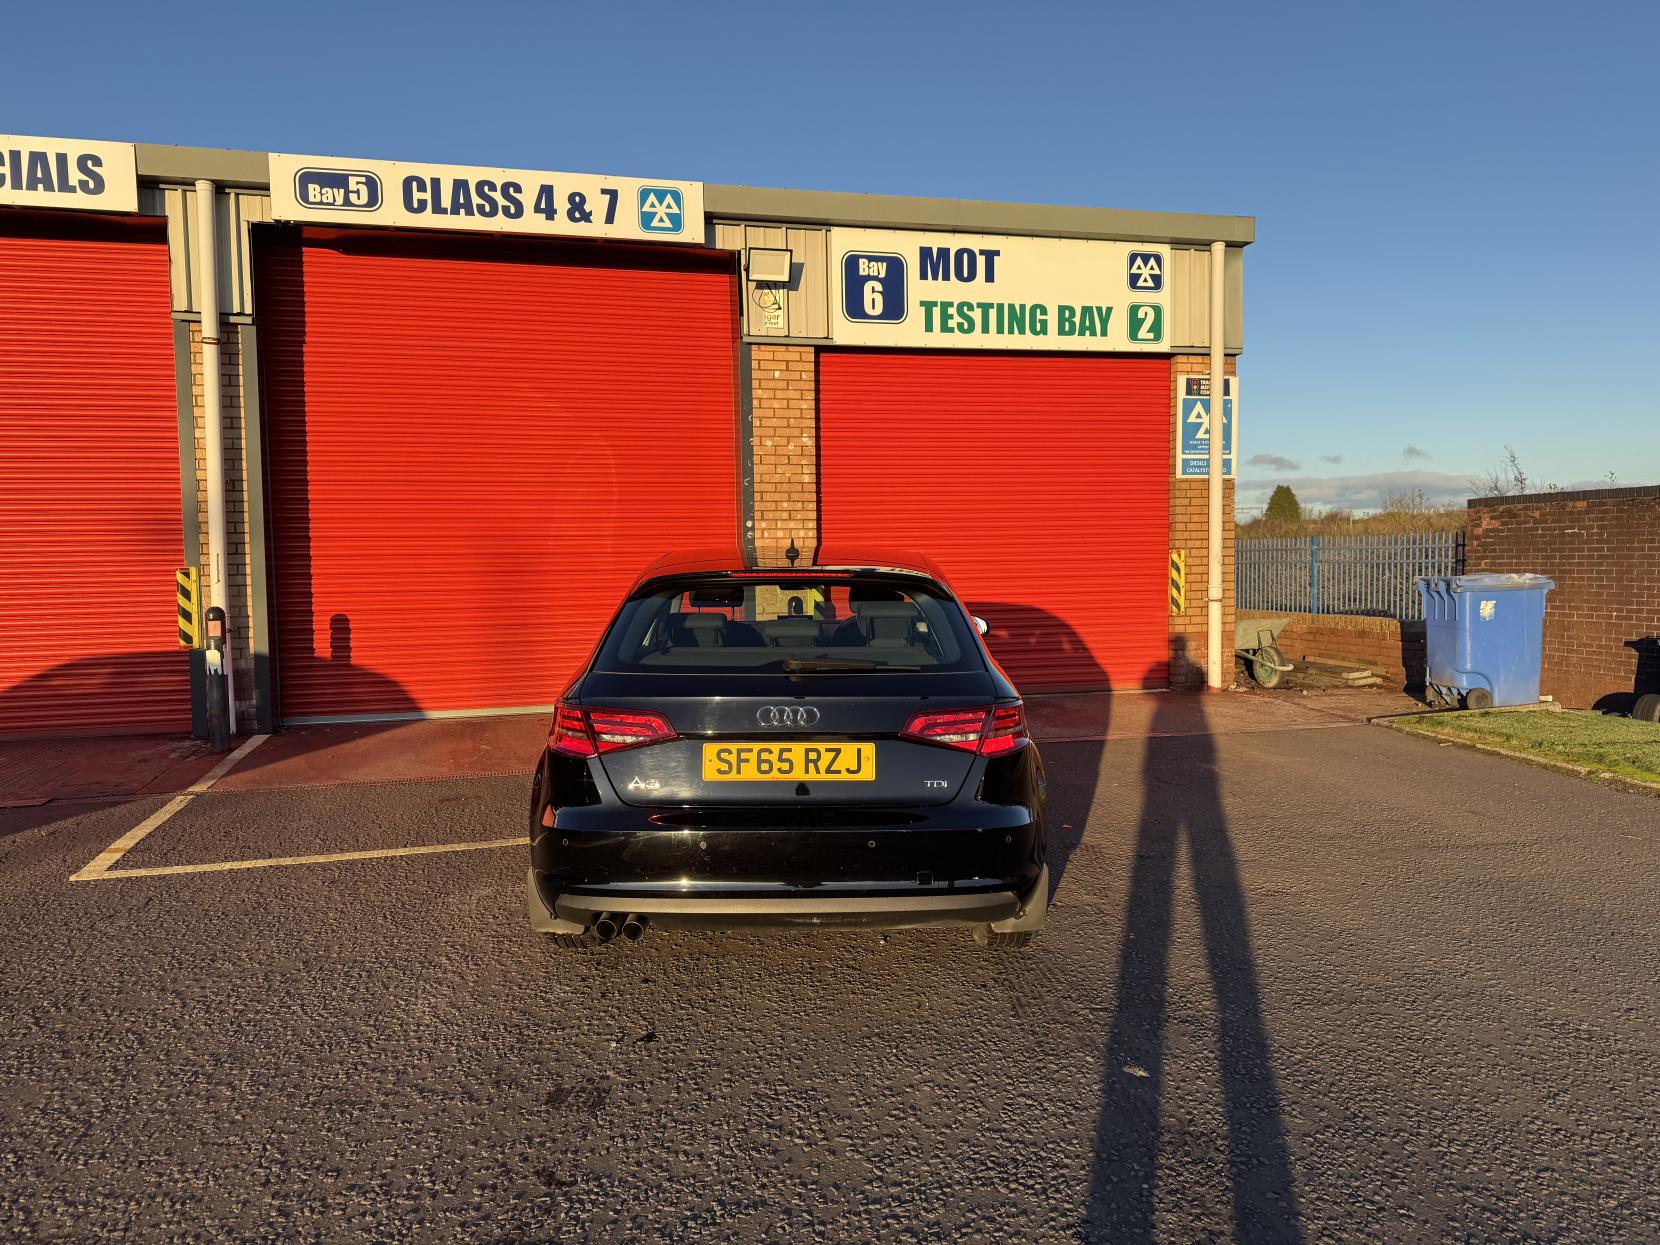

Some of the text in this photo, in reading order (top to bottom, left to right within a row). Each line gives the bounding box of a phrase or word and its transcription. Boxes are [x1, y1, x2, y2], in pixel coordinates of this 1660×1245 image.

[0, 149, 106, 196] IALS
[307, 176, 368, 206] Bay 5
[402, 175, 619, 225] CLASS 4 & 7
[858, 258, 887, 278] Bay
[919, 246, 1001, 283] MOT
[863, 280, 884, 316] 6
[919, 300, 1113, 338] TESTING BAY
[1137, 306, 1155, 340] 2
[716, 748, 862, 775] SF65 RZJ
[923, 780, 948, 788] TDI
